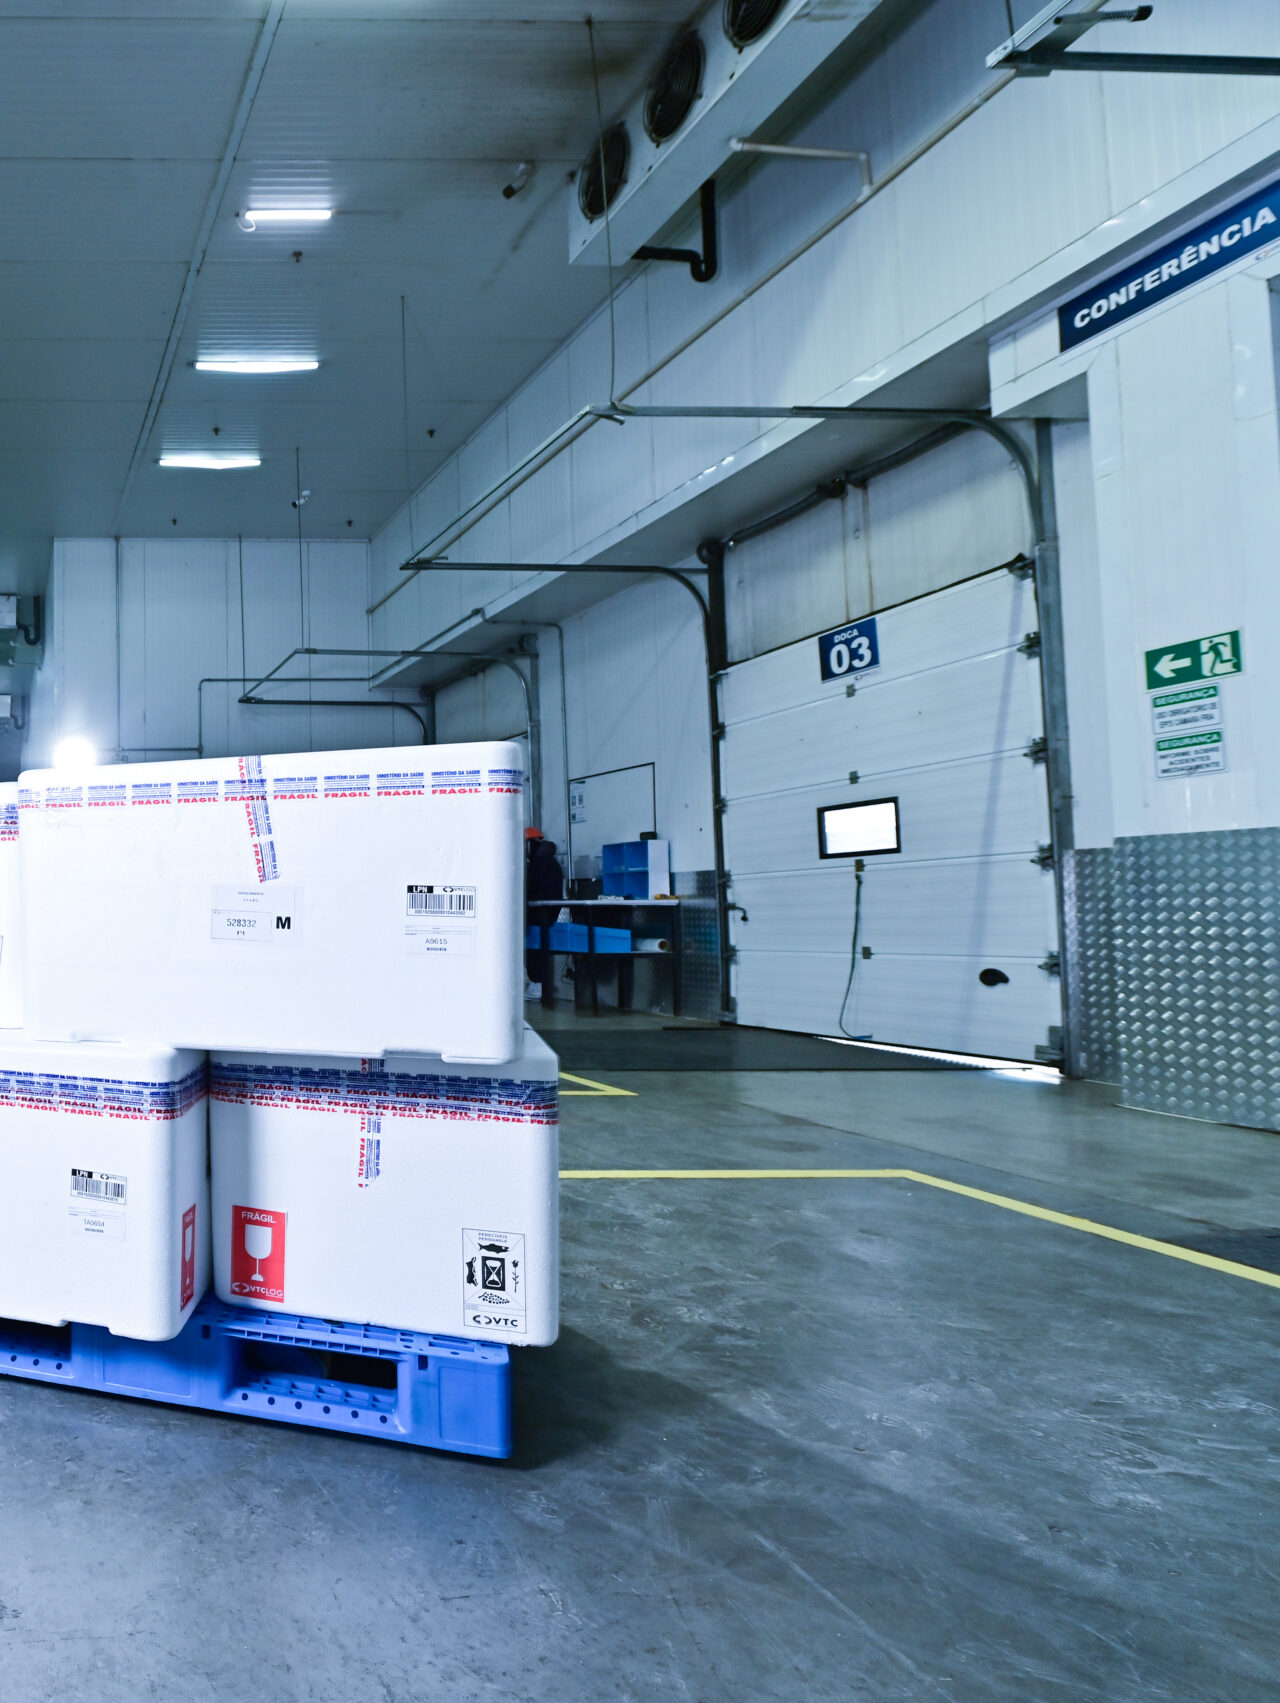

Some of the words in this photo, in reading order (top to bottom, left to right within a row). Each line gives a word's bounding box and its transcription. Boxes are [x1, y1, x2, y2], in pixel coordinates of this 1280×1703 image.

[1073, 206, 1277, 328] CONFERÊNCIA
[833, 628, 859, 643] DOCA
[830, 636, 872, 674] 03
[226, 918, 257, 928] 528332
[275, 916, 291, 929] M
[241, 1211, 276, 1224] FRÁGIL
[250, 1286, 284, 1298] VTCLOG
[493, 1316, 518, 1328] VTC
